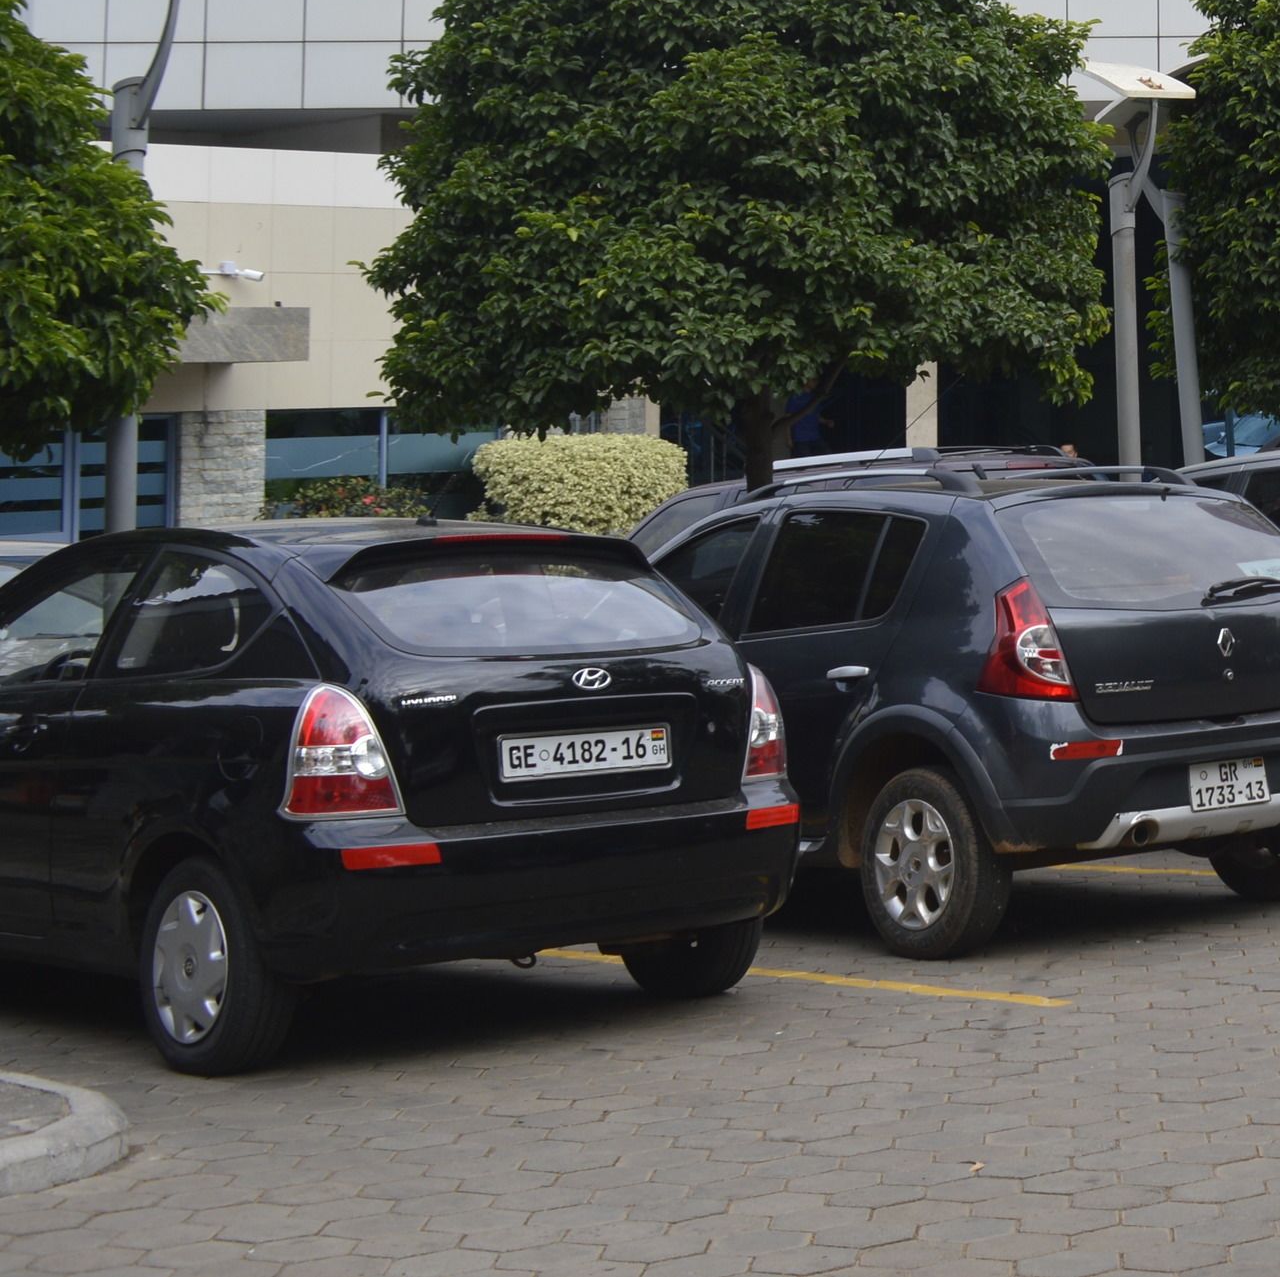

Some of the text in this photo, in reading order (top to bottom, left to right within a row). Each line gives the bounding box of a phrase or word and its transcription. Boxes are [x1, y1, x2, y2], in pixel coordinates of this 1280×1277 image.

[508, 735, 647, 770] GE 4182-16
[651, 744, 666, 756] GH
[1219, 761, 1239, 783] GR
[1195, 780, 1266, 808] 1733-13
